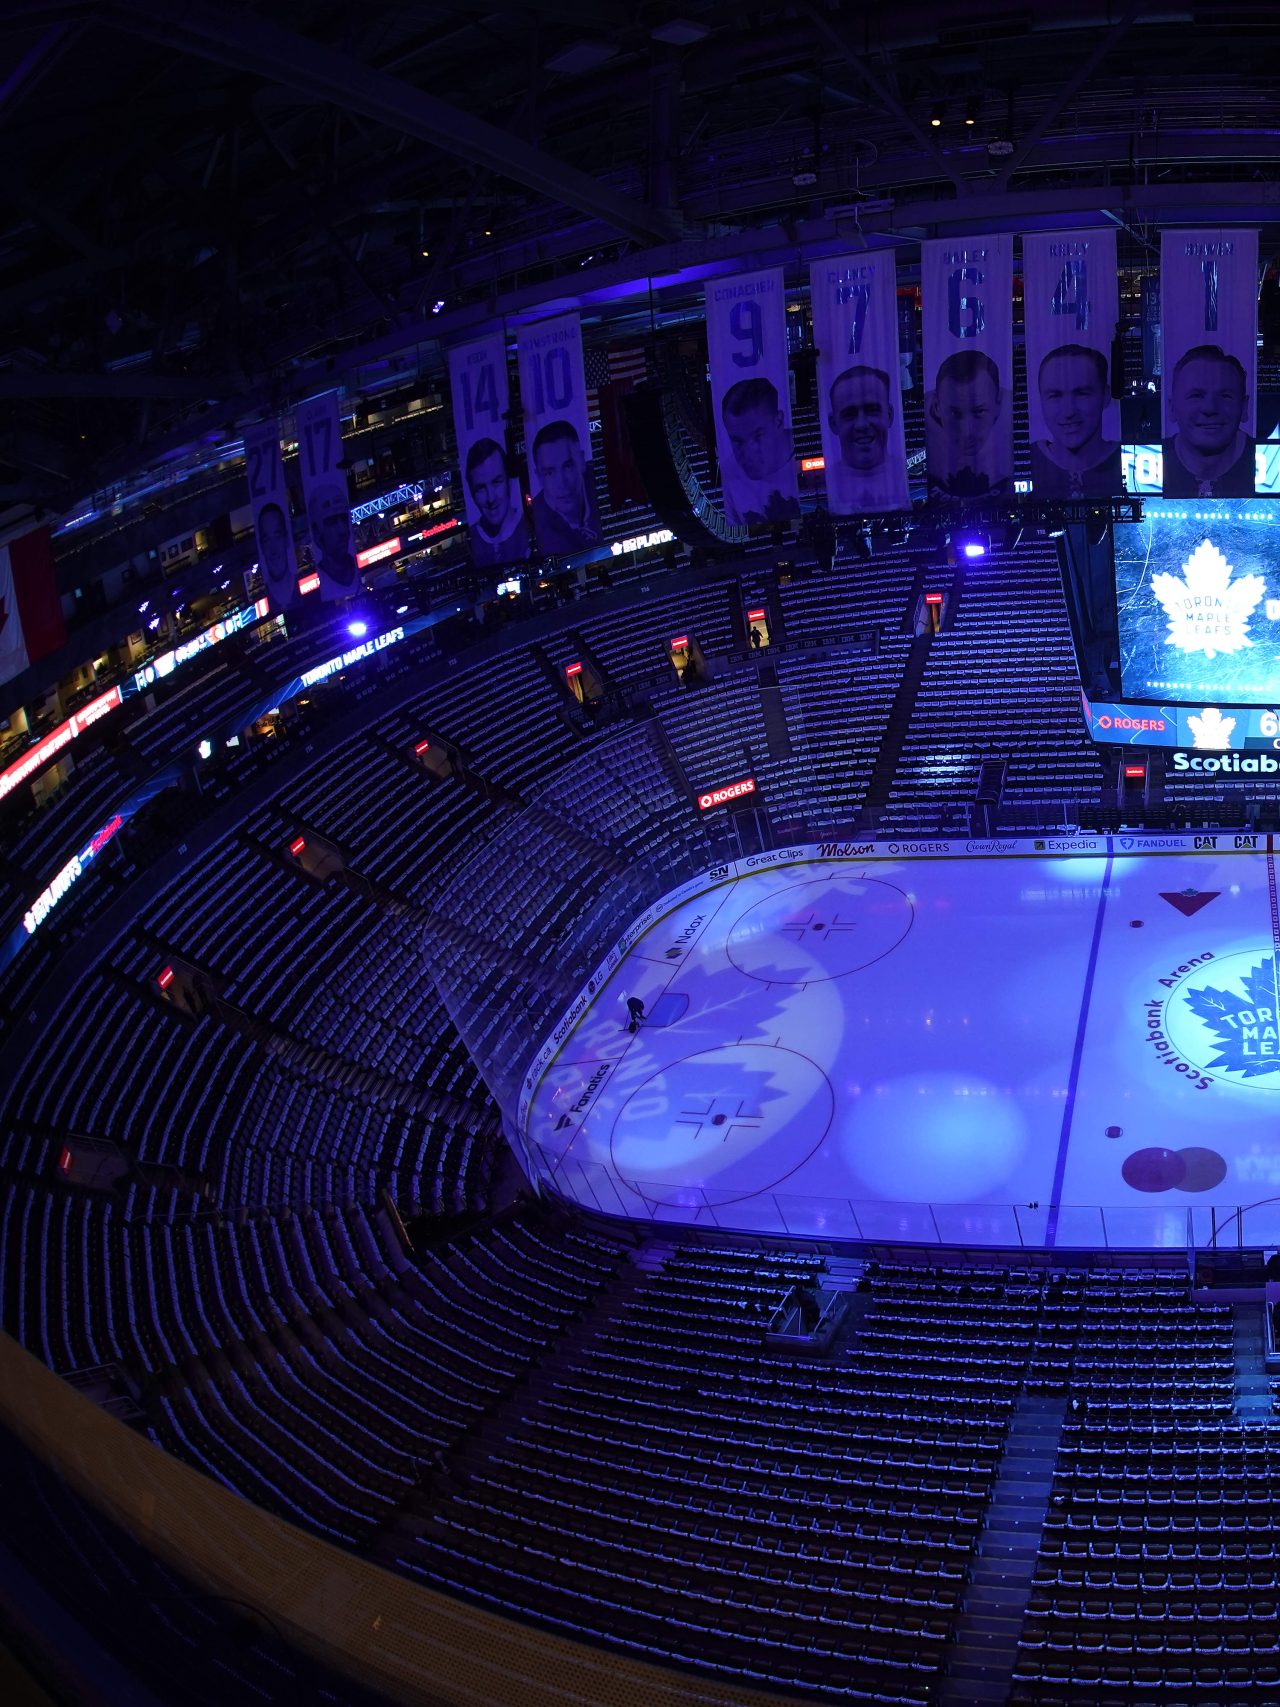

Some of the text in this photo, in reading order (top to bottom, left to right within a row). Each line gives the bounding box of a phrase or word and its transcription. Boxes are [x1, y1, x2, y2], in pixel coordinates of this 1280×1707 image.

[948, 268, 985, 338] 6
[1051, 261, 1089, 330] 4
[1202, 261, 1218, 331] 1
[835, 284, 870, 354] 7
[730, 301, 764, 368] 9
[530, 346, 573, 415] 10
[460, 363, 499, 431] 14
[304, 415, 333, 477] 17
[248, 438, 278, 499] 27
[374, 626, 405, 651] LEAFS
[1114, 717, 1166, 731] ROGERS
[713, 779, 755, 803] ROGERS
[816, 843, 875, 857] Molson
[902, 843, 950, 853] ROGERS
[1048, 839, 1097, 851] Expedia
[1137, 839, 1187, 848] FANDUEL
[1194, 836, 1218, 849] CAT
[1234, 835, 1258, 848] CAT
[709, 865, 729, 879] SN
[746, 848, 804, 867] Great Clips
[675, 914, 707, 944] Ndax
[594, 973, 604, 986] LG
[553, 995, 587, 1044] Scotiabank
[1144, 951, 1215, 1090] Scotiabank Arena
[570, 1063, 611, 1113] Fanatics
